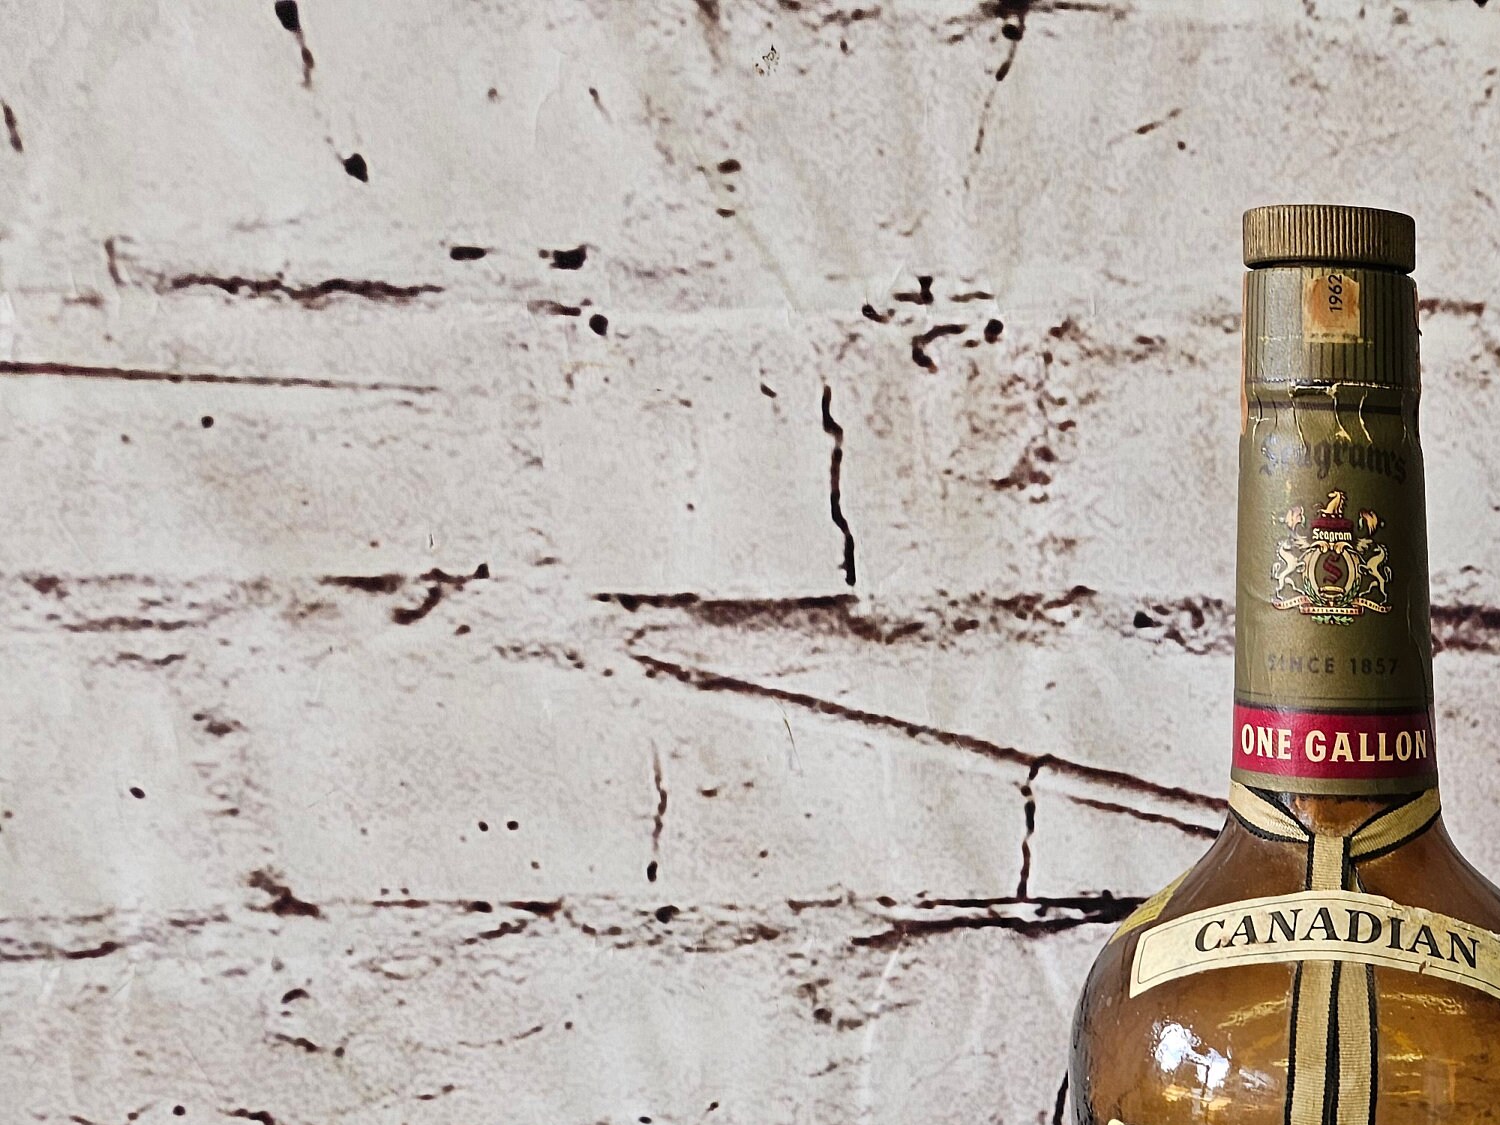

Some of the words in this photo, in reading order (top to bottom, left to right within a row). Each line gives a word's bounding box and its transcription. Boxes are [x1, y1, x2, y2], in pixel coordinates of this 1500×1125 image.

[1328, 274, 1343, 313] 1962
[1312, 528, 1353, 542] Seagram
[1269, 654, 1335, 674] SINCE
[1351, 658, 1399, 675] 1857
[1241, 723, 1292, 760] ONE
[1305, 729, 1427, 762] GALLON
[1195, 907, 1480, 968] CANADIAN
